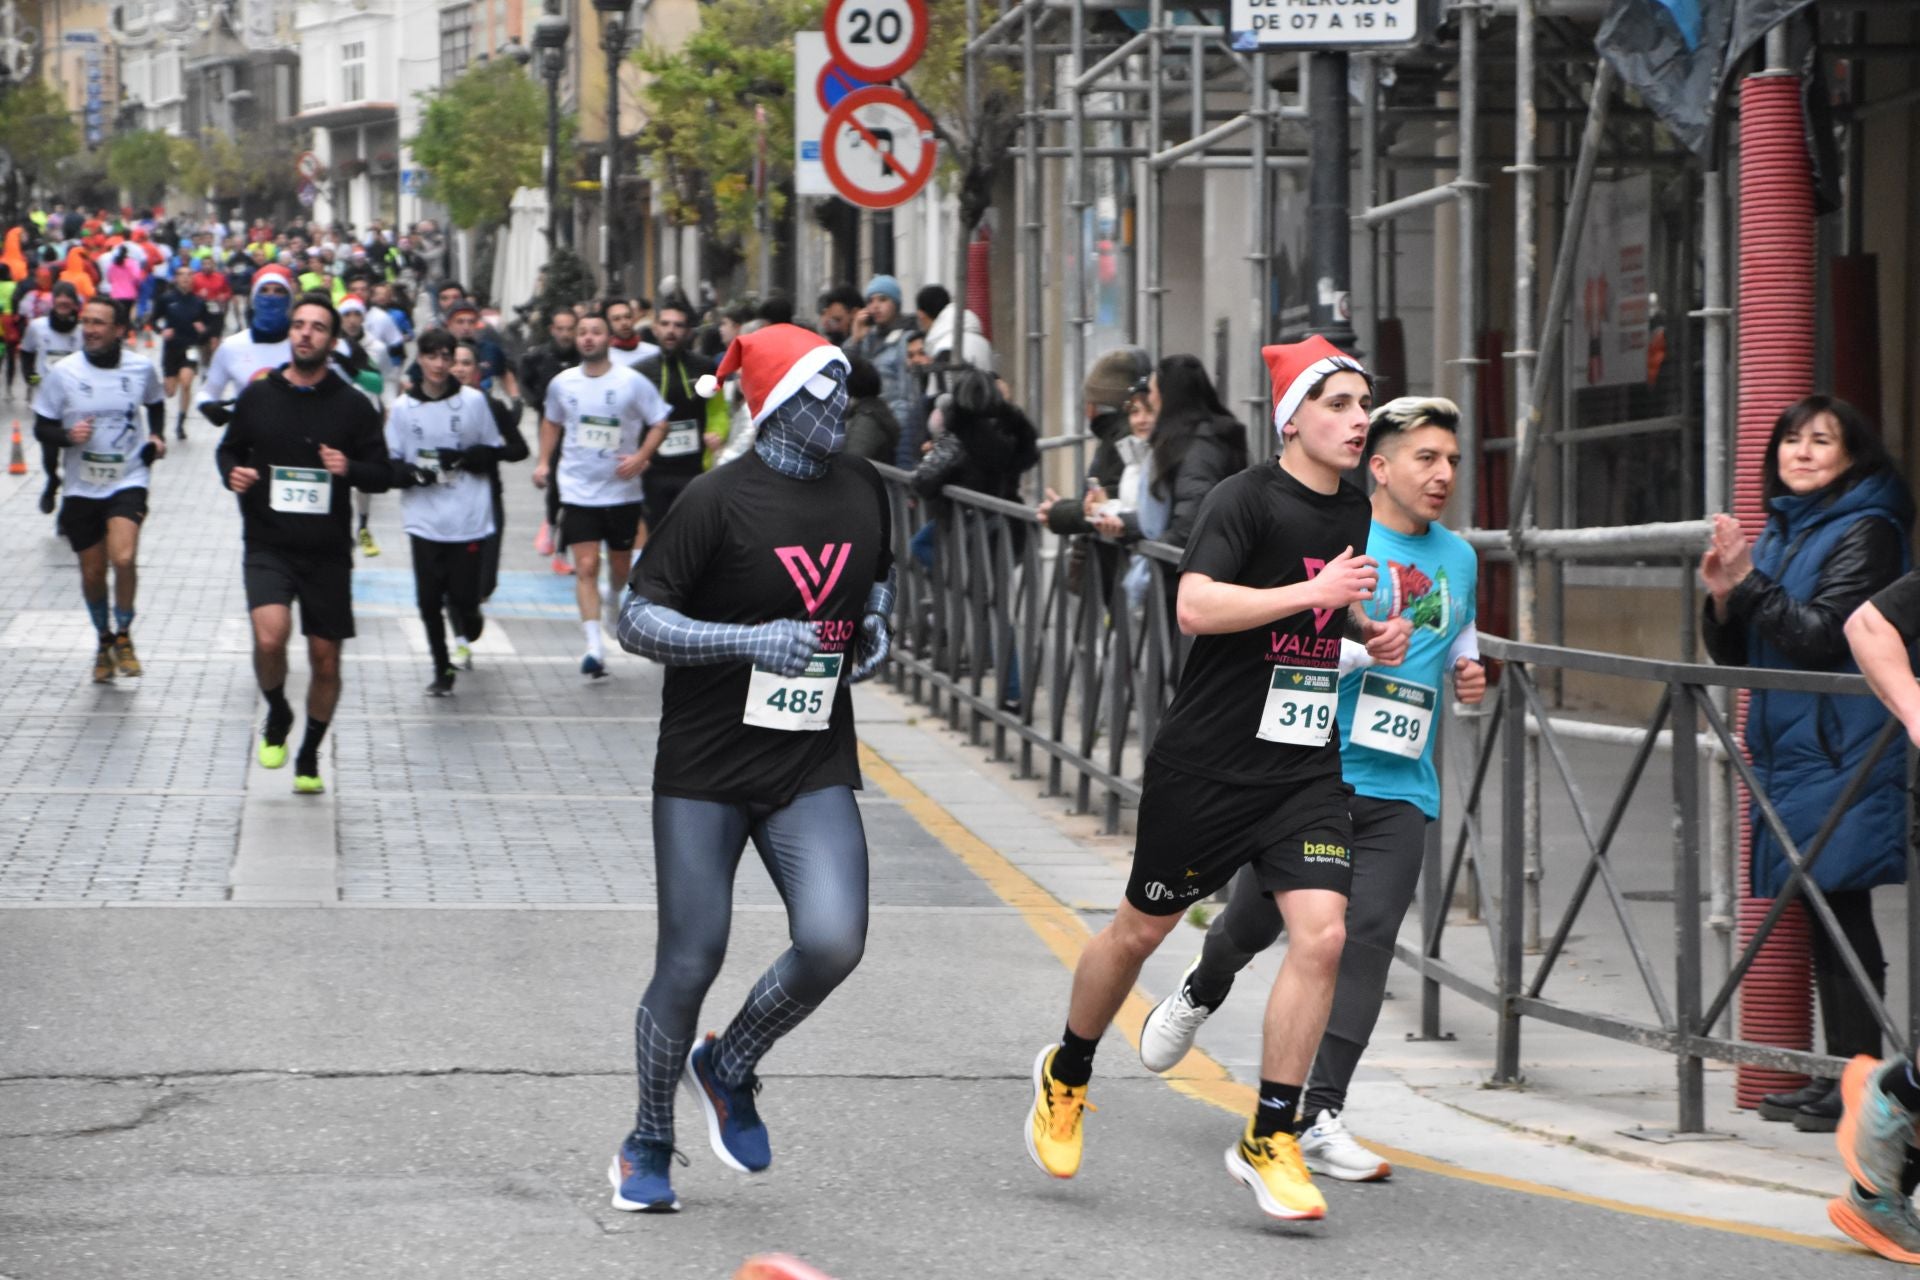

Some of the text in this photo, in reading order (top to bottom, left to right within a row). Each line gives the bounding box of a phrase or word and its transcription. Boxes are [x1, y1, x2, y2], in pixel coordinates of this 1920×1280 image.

[848, 8, 903, 44] 20
[1252, 12, 1397, 30] DE 07 A 15 h
[586, 430, 612, 441] 171
[88, 466, 117, 479] 172
[282, 487, 319, 503] 376
[766, 687, 824, 714] 485
[1279, 702, 1330, 730] 319
[1370, 709, 1421, 741] 289
